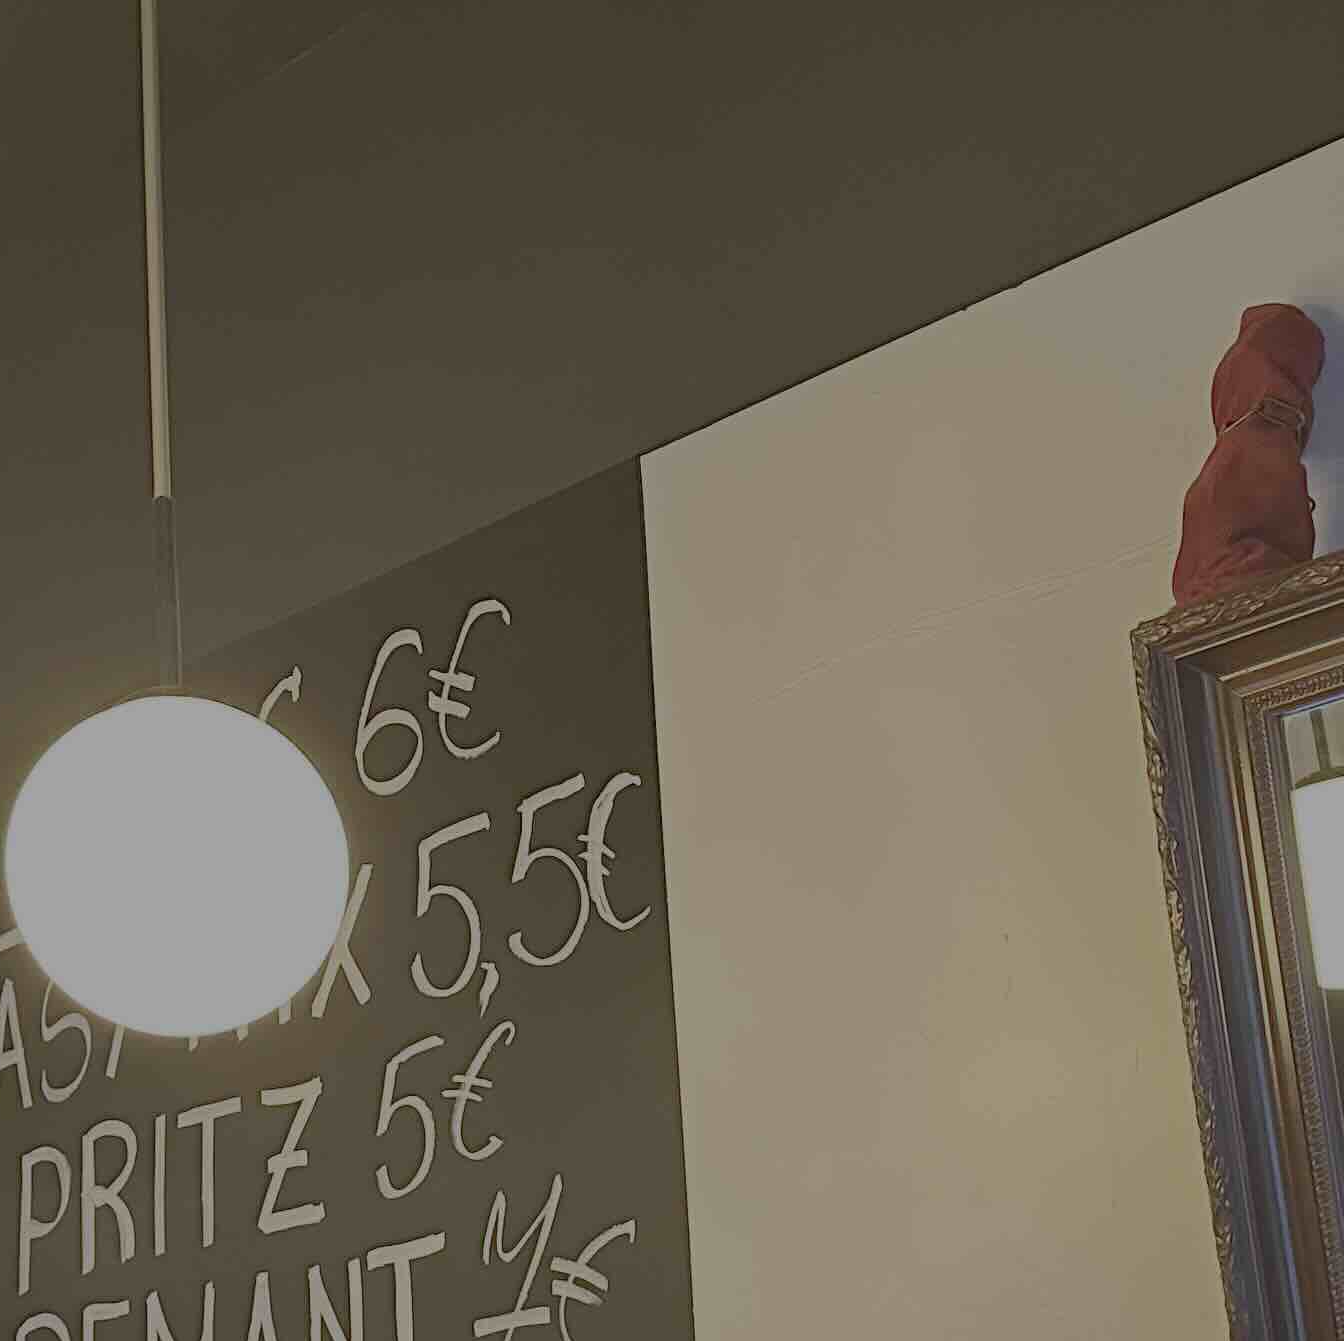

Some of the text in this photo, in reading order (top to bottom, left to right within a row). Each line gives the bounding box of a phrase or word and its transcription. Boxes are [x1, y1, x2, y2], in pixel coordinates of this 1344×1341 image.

[354, 598, 512, 797] 6€
[409, 771, 652, 1018] 5,5€
[373, 1019, 518, 1201] 5€
